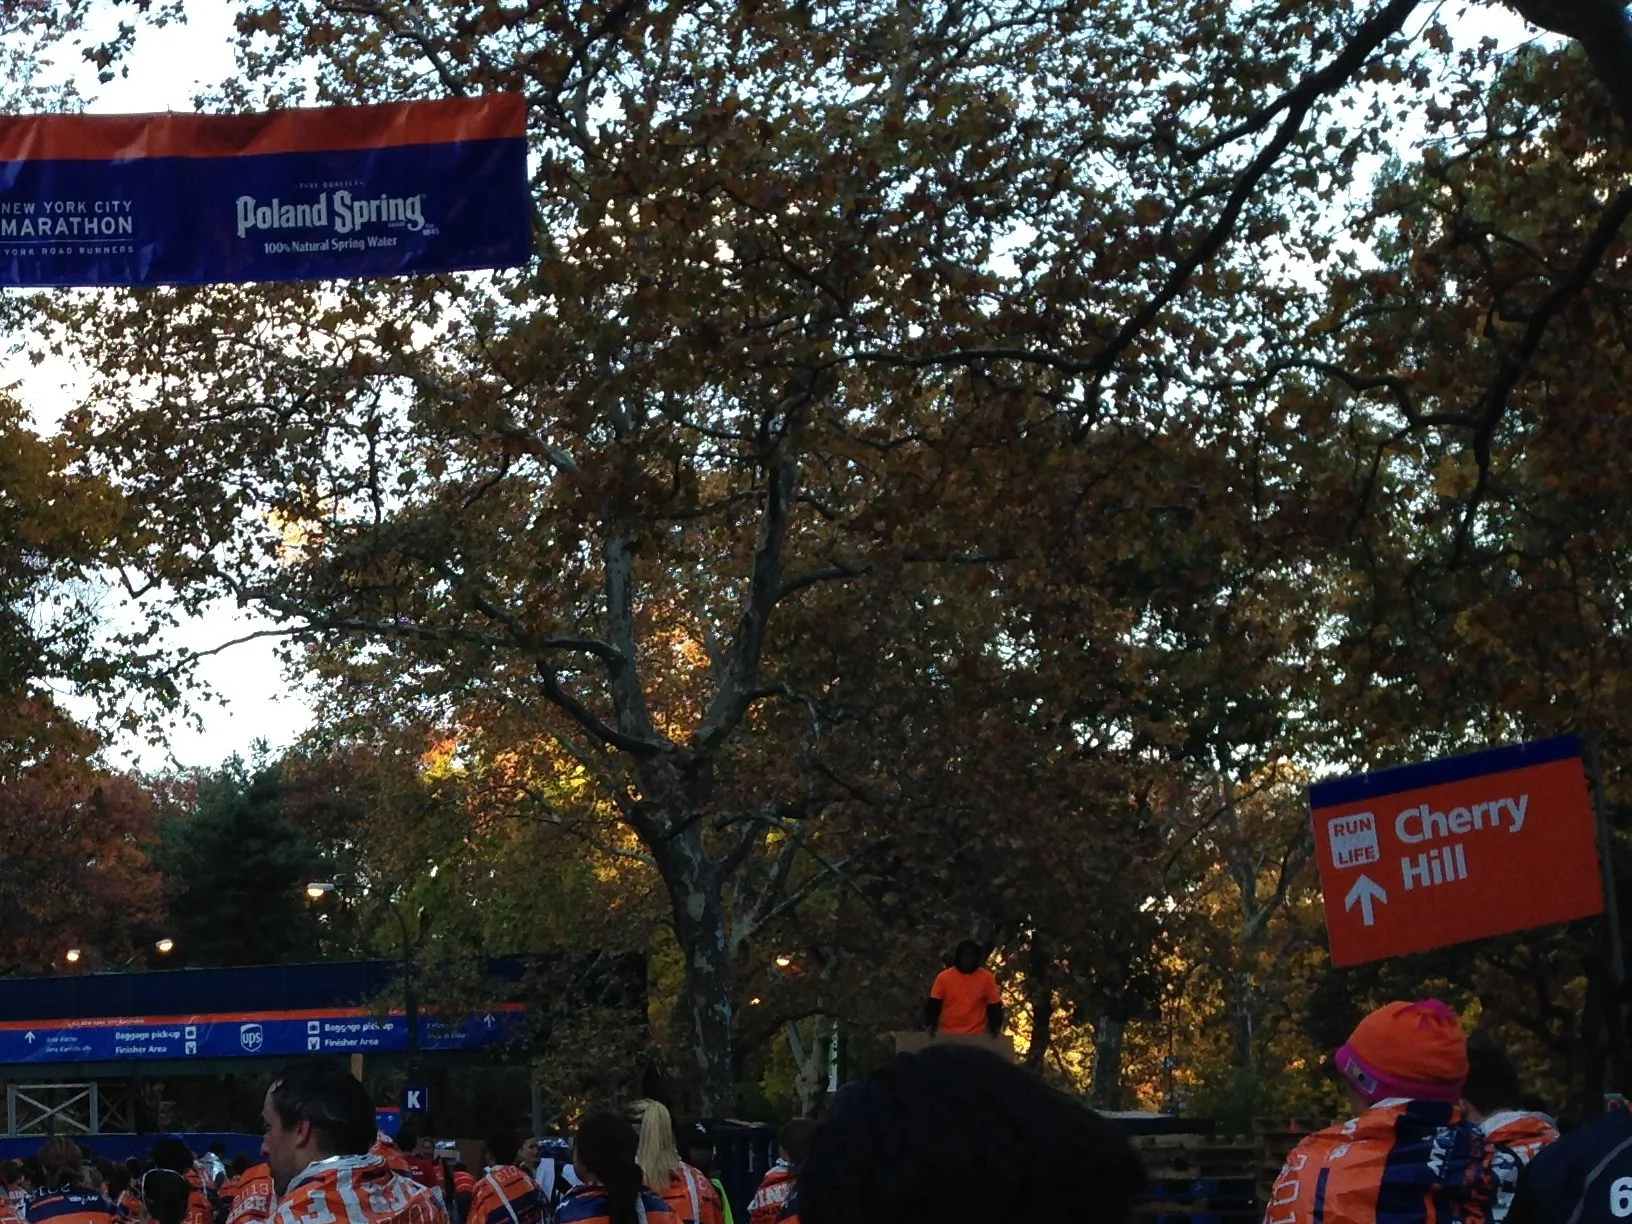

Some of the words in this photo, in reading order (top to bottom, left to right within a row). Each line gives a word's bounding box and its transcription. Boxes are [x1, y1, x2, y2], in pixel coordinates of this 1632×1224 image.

[1, 202, 35, 215] NEW
[43, 200, 87, 214] YORK
[94, 200, 133, 214] CITY
[236, 191, 328, 238] Poland
[332, 189, 426, 234] Spring
[1, 216, 133, 236] MARATHON
[4, 247, 35, 256] YORK
[78, 245, 134, 255] RUNNERS
[292, 239, 329, 252] Natural
[331, 237, 365, 251] Spring
[367, 235, 398, 248] Water
[1333, 817, 1372, 838] RUN
[1394, 793, 1529, 845] Cherry
[1338, 845, 1375, 865] LIFE
[1400, 843, 1468, 892] Hill
[115, 1031, 150, 1043] Baggage
[242, 1032, 262, 1048] ups
[360, 1038, 379, 1047] Area
[149, 1045, 167, 1053] Area
[407, 1090, 421, 1110] K
